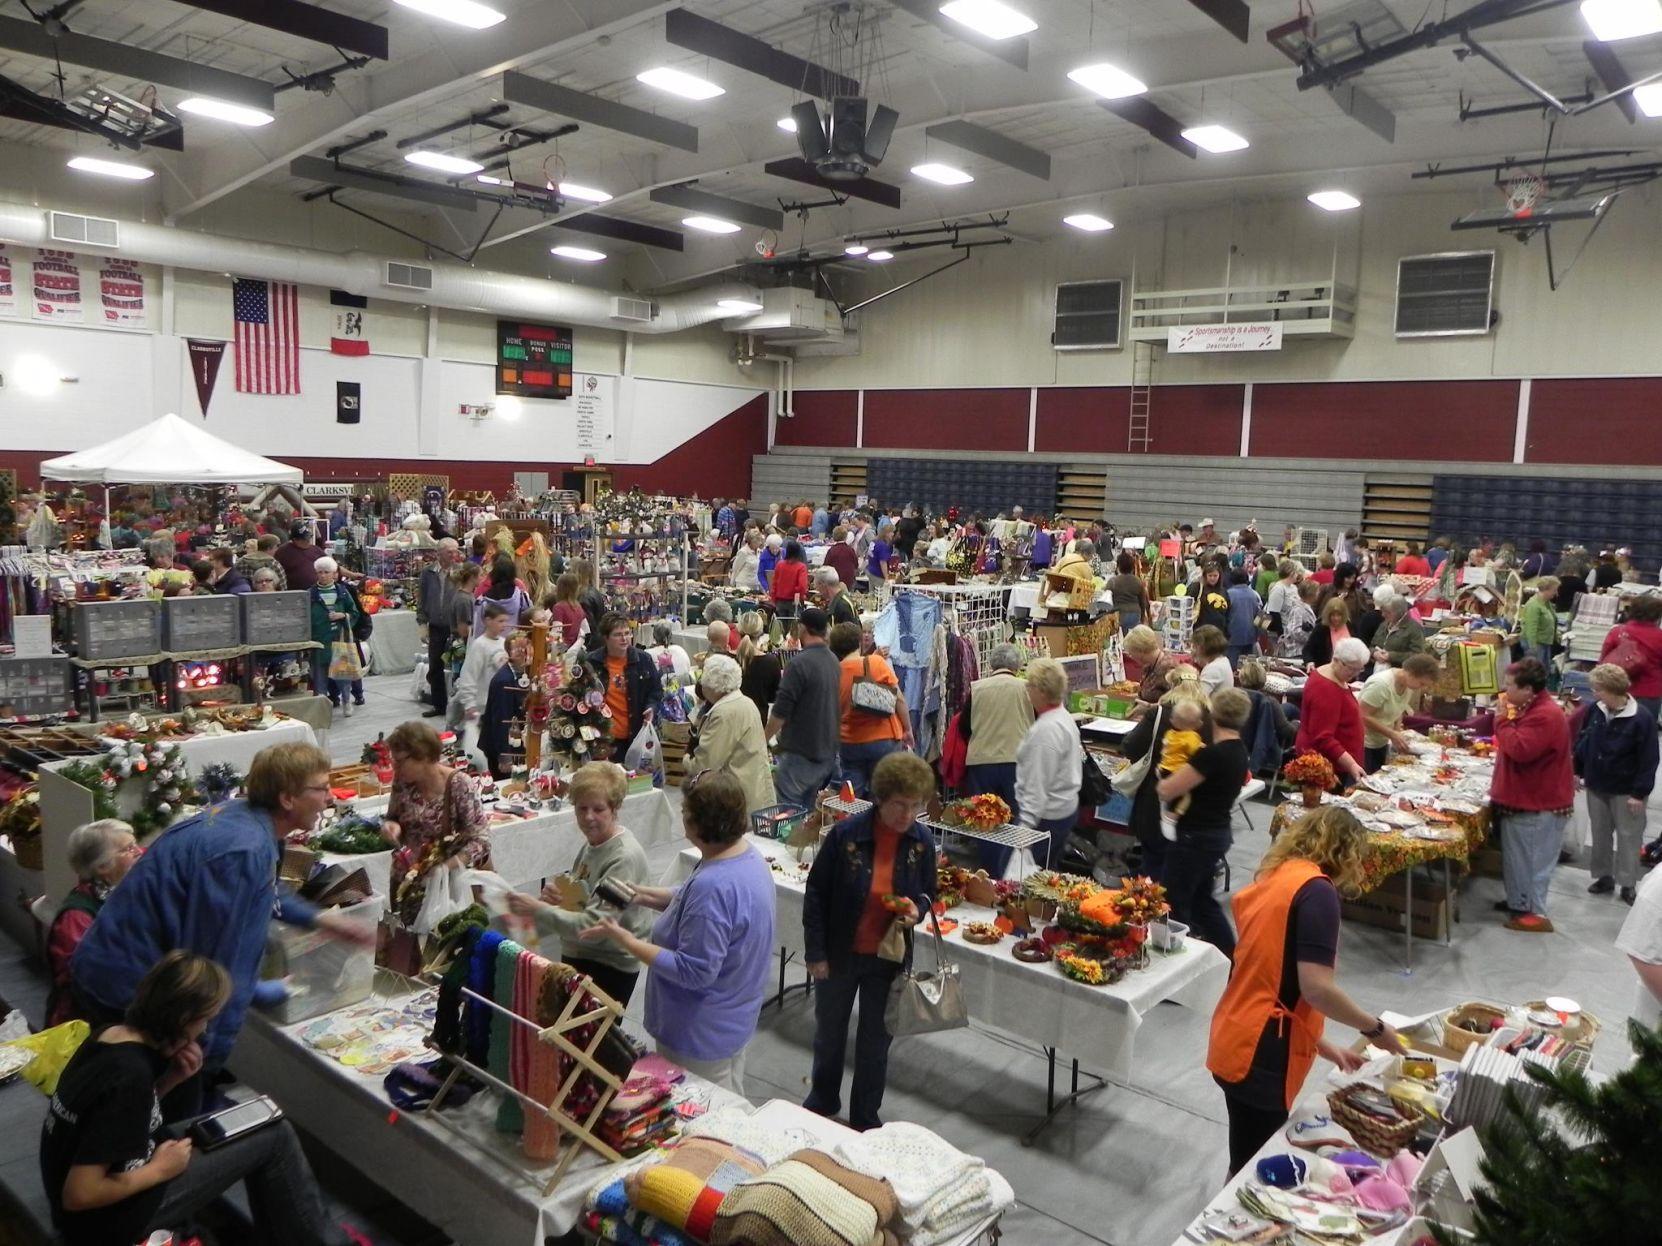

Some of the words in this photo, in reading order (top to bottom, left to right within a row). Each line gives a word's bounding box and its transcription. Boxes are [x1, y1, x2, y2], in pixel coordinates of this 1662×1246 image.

[33, 261, 80, 276] FOOTBALL
[99, 270, 144, 284] FOOTBALL
[1195, 325, 1237, 337] Sportsmanship
[1248, 325, 1271, 335] Journey
[506, 336, 522, 346] HOME
[550, 342, 572, 350] VISITOR
